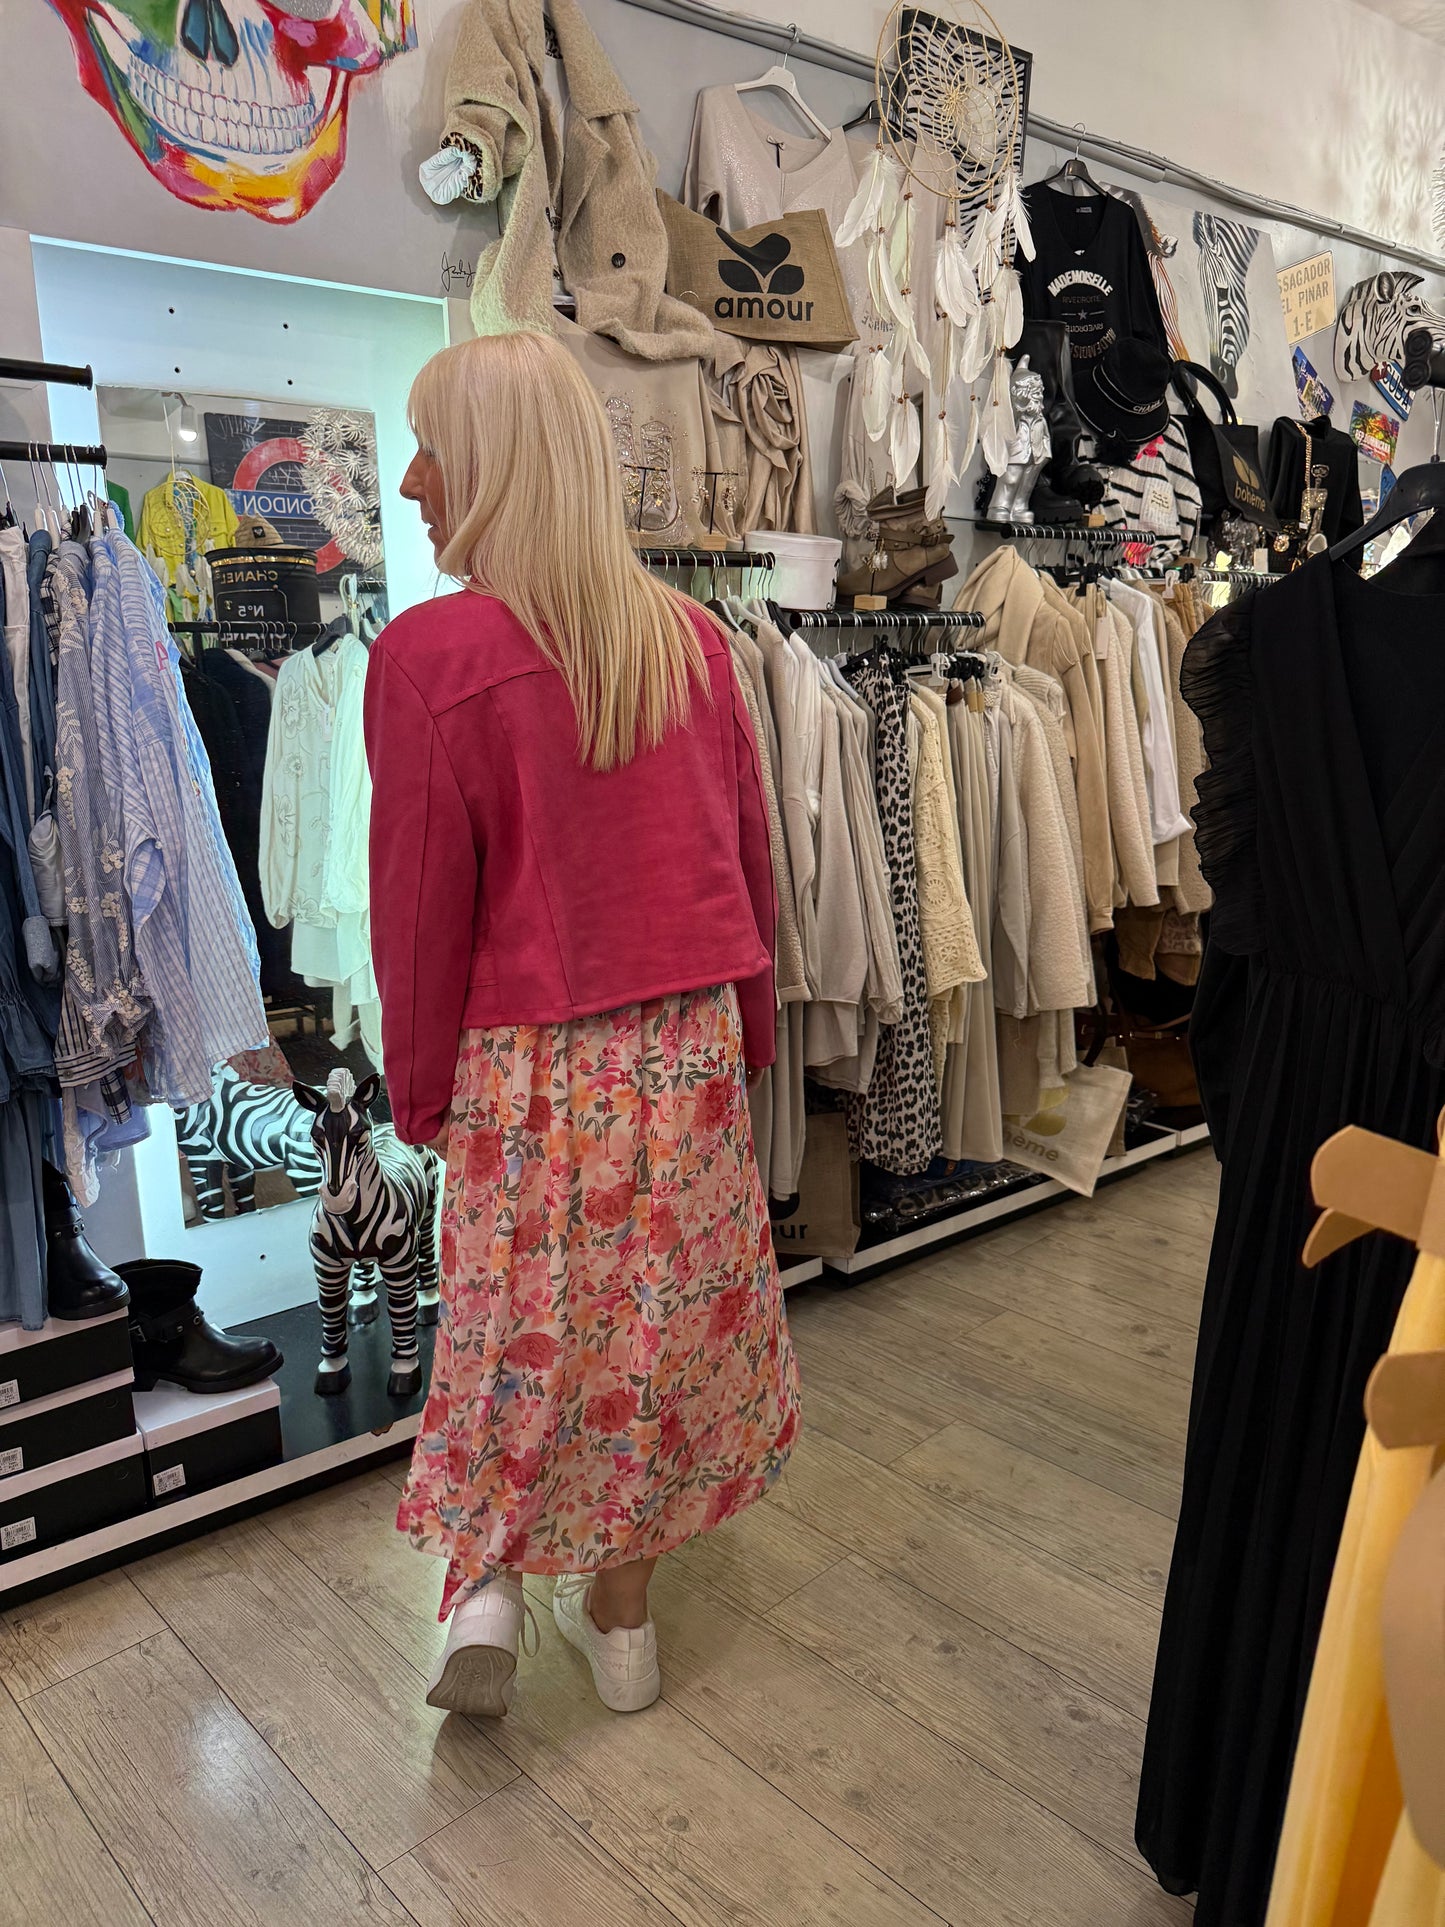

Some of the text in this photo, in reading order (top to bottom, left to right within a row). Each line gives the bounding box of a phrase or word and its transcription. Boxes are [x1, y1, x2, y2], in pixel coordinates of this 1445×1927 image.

[1047, 269, 1113, 297] MADEMOISELLE
[1298, 281, 1329, 307] PINAR
[714, 296, 814, 322] amour
[1384, 363, 1412, 411] CUBA
